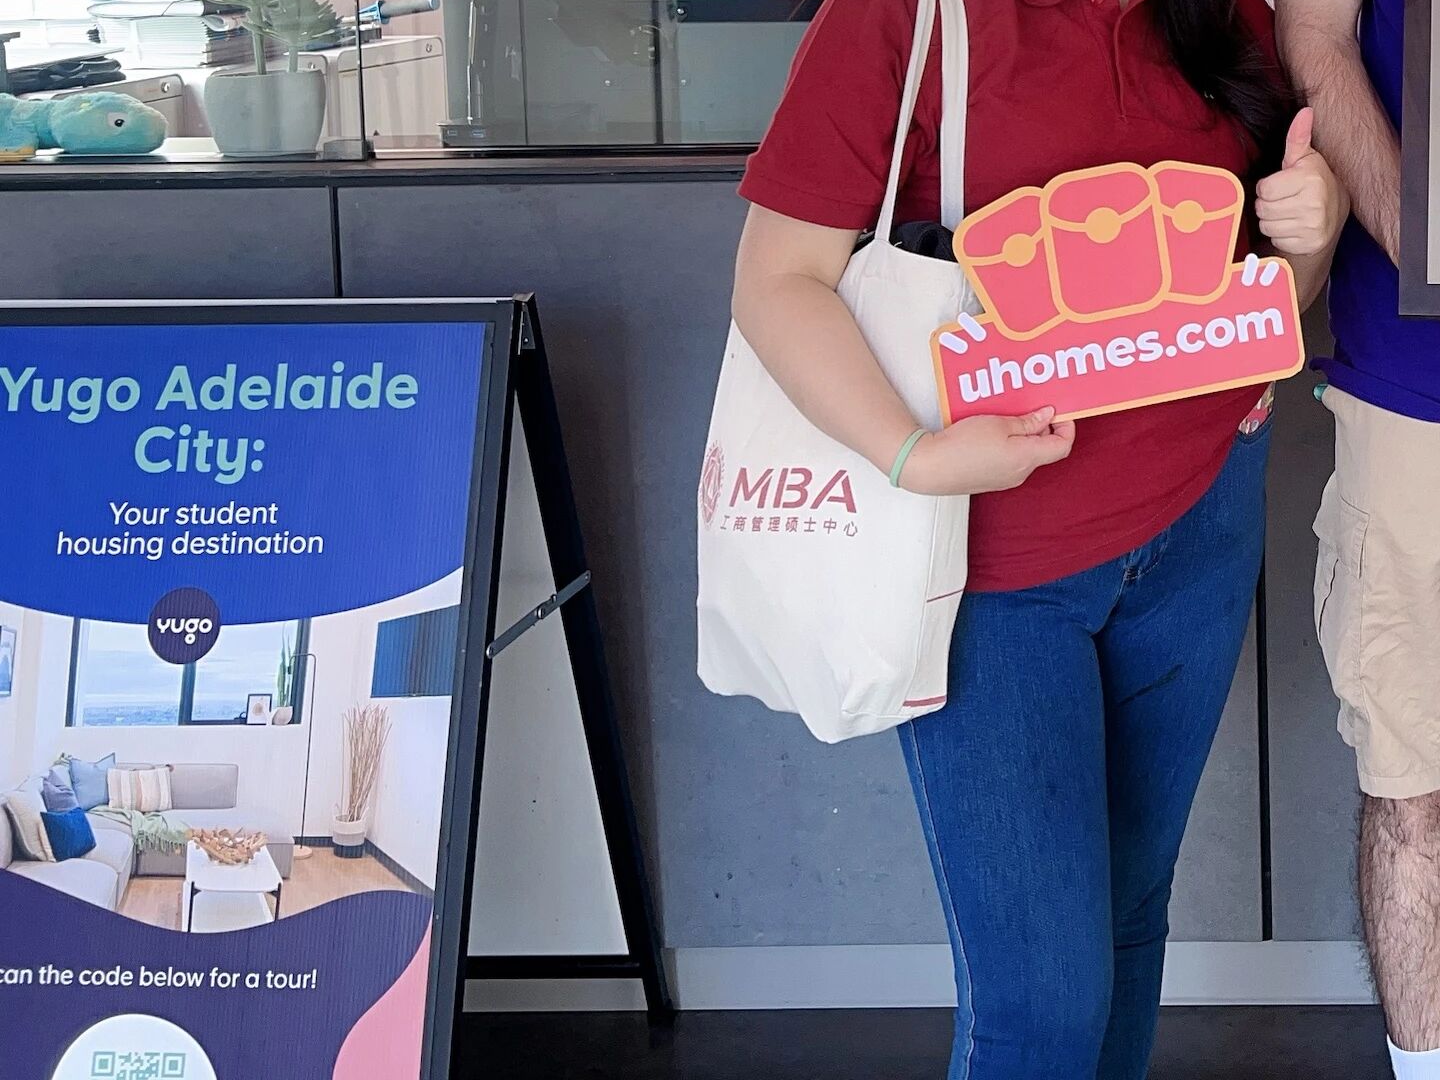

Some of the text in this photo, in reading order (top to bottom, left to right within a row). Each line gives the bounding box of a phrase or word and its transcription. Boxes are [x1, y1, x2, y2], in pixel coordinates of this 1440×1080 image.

[958, 306, 1285, 404] uhomes.com
[0, 361, 418, 423] Yugo Adelaide
[134, 424, 265, 484] City:
[729, 467, 857, 513] MBA
[109, 500, 278, 525] Your student
[56, 531, 323, 560] housing destination
[157, 618, 212, 644] yugo
[39, 964, 73, 985] the
[79, 966, 133, 986] code
[139, 967, 204, 987] below
[209, 968, 238, 988] for
[245, 972, 259, 988] a
[266, 969, 317, 989] tour!
